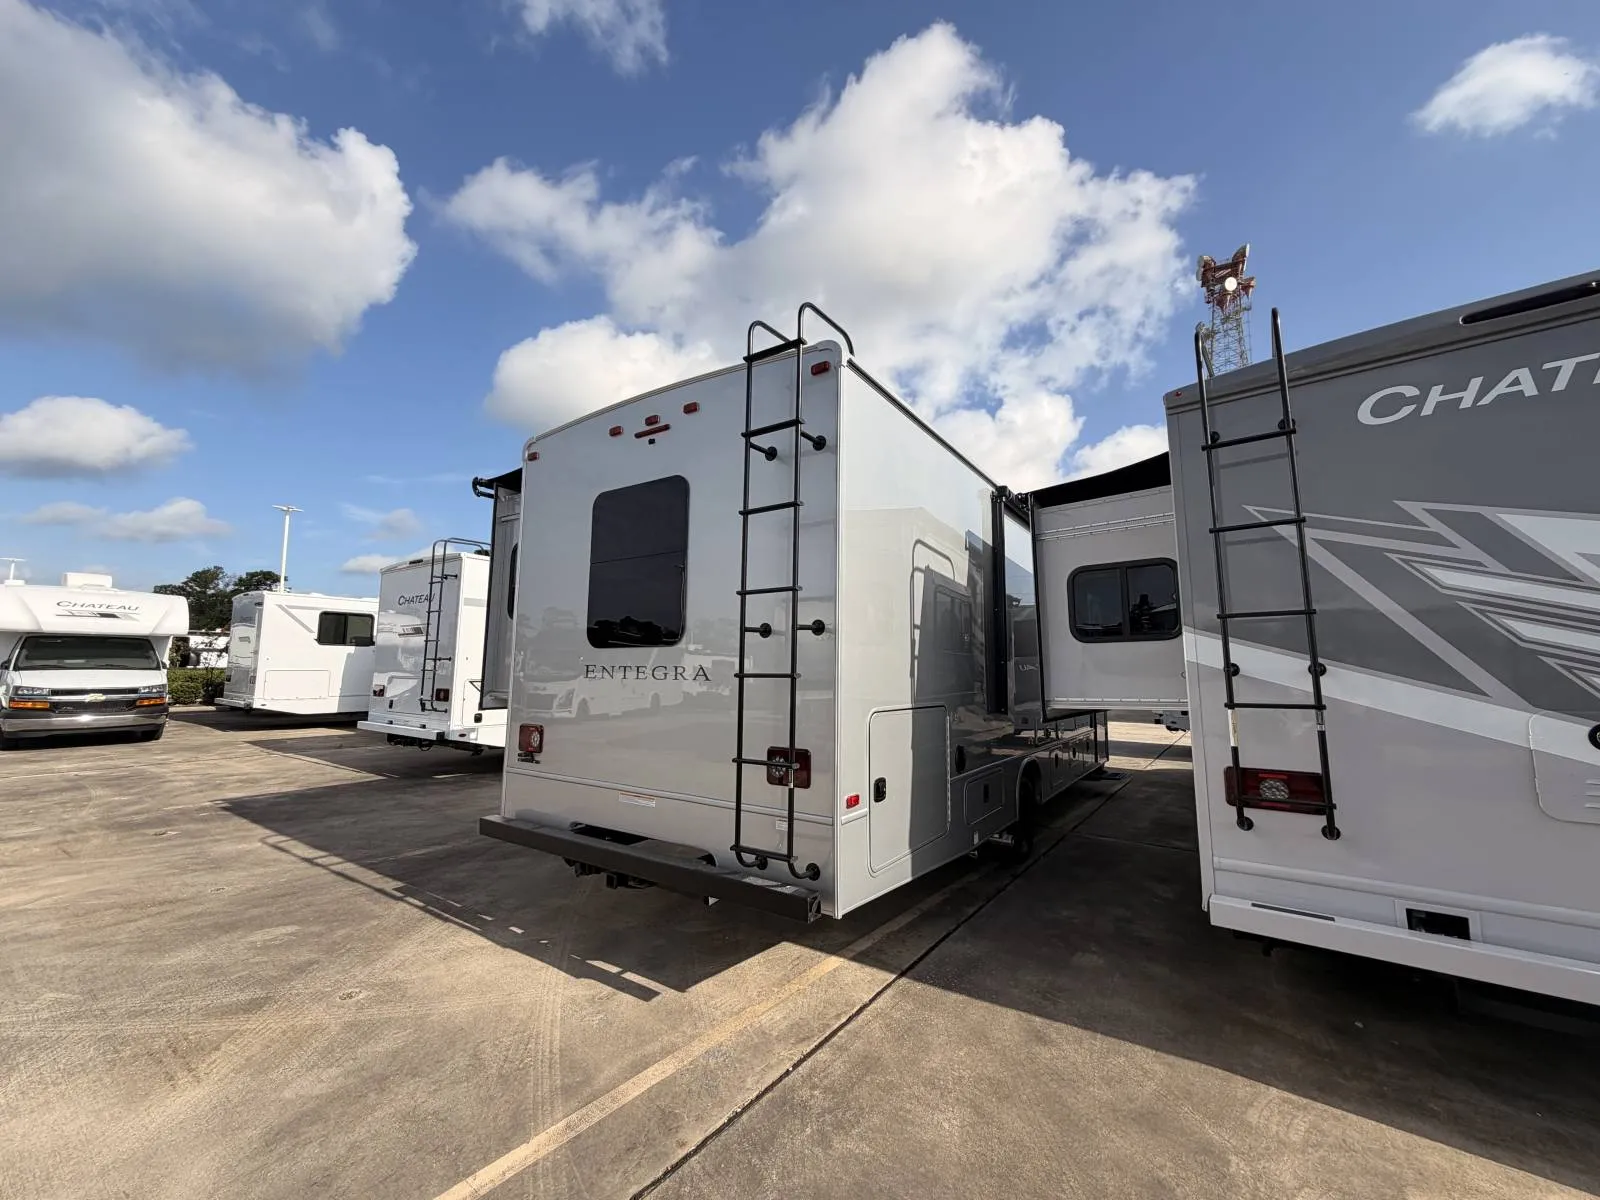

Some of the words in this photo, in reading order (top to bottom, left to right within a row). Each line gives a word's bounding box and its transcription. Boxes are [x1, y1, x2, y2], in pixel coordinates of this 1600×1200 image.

[1357, 352, 1600, 426] CHAT
[56, 600, 140, 611] CHATEAU
[584, 664, 712, 682] ENTEGRA
